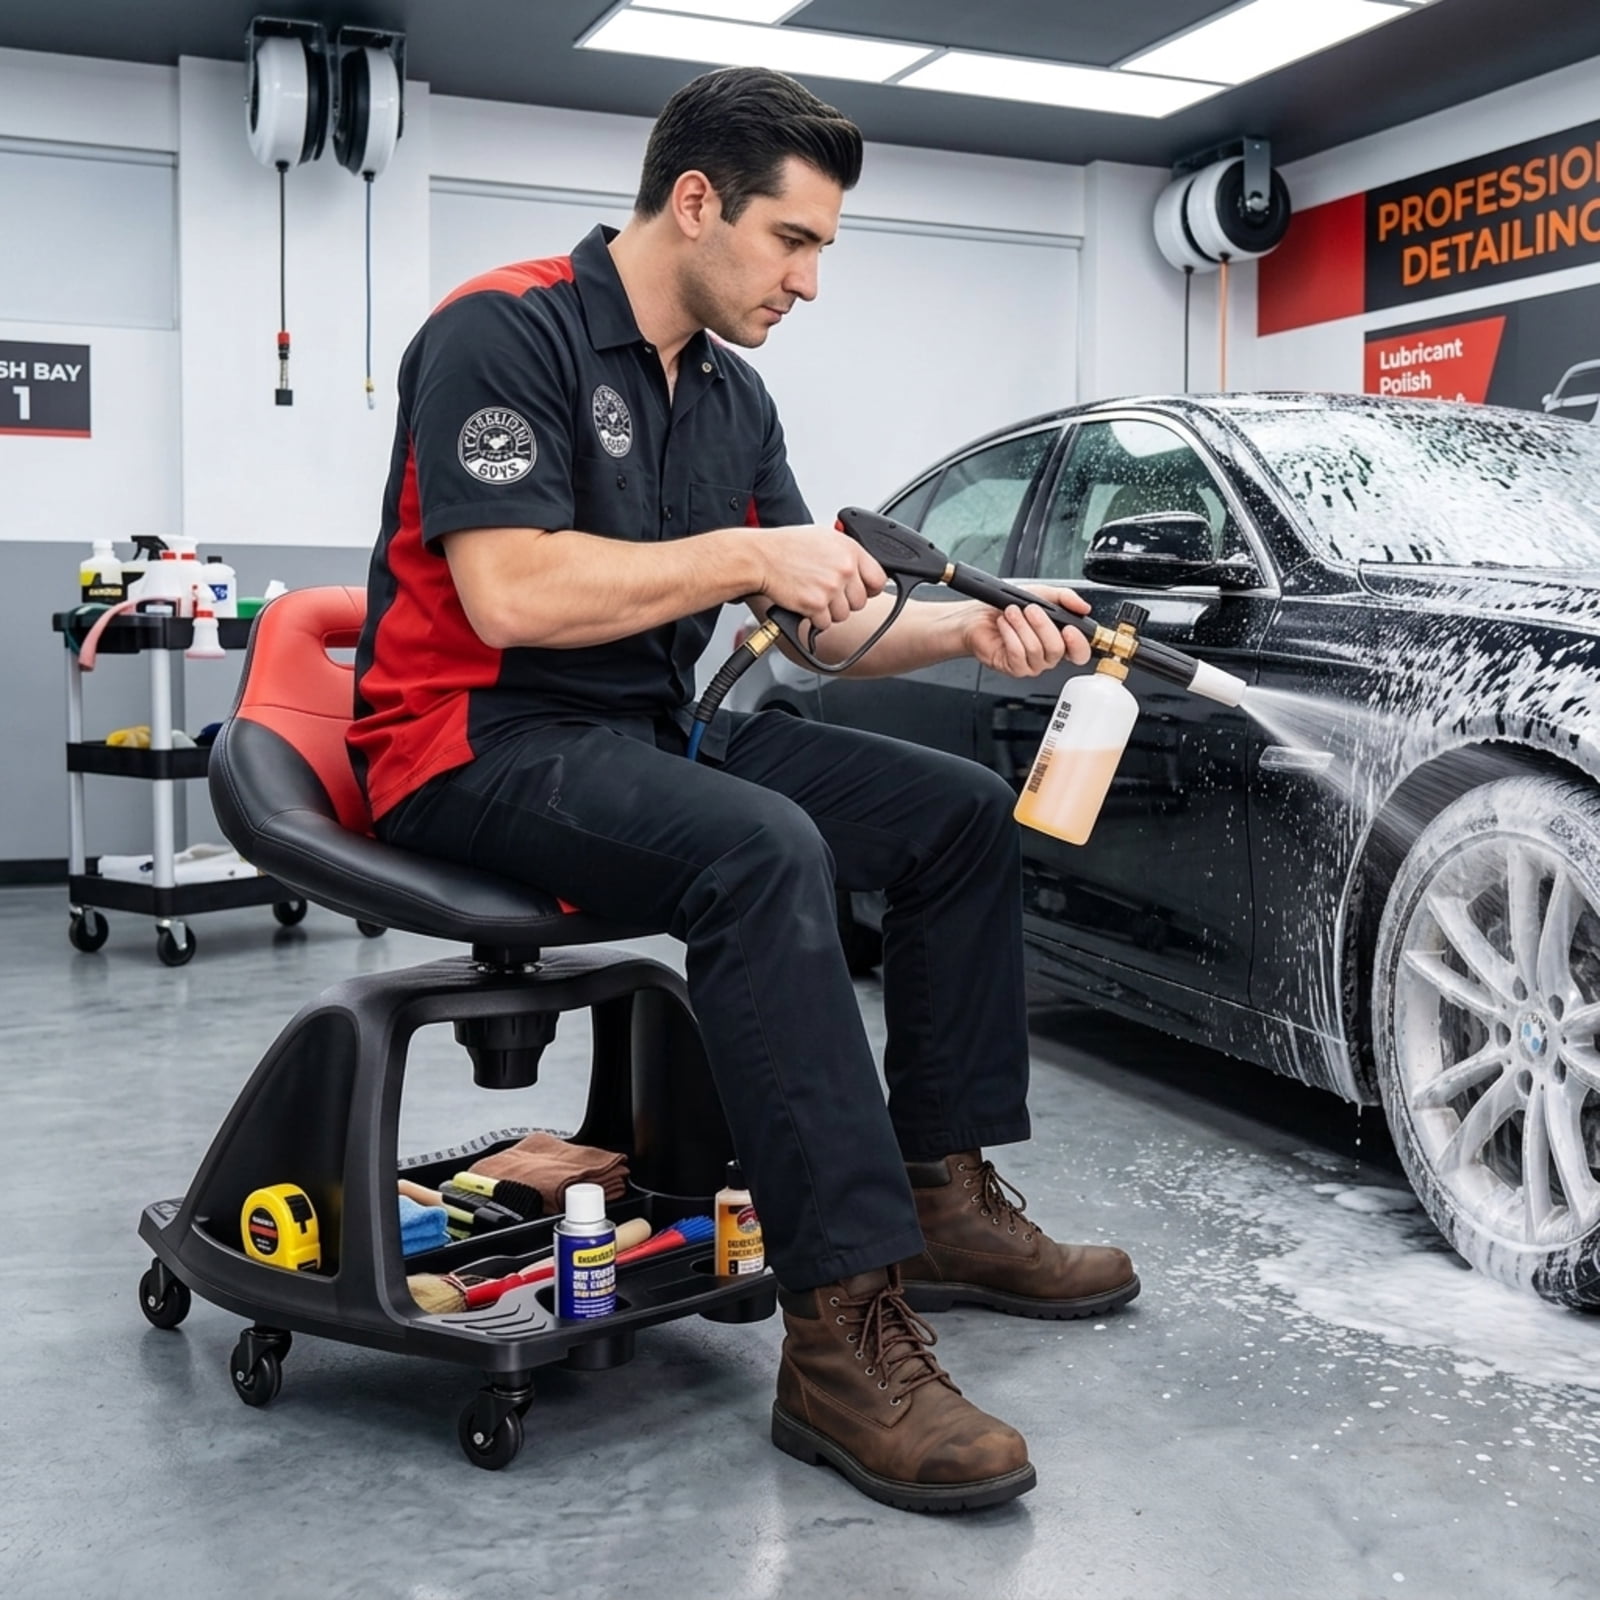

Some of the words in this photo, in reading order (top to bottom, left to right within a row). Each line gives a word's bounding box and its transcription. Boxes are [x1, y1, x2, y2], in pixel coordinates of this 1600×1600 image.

[1379, 141, 1600, 242] PROFESSIO
[1380, 338, 1463, 370] Lubricant
[34, 362, 82, 382] BAY
[13, 386, 30, 420] 1
